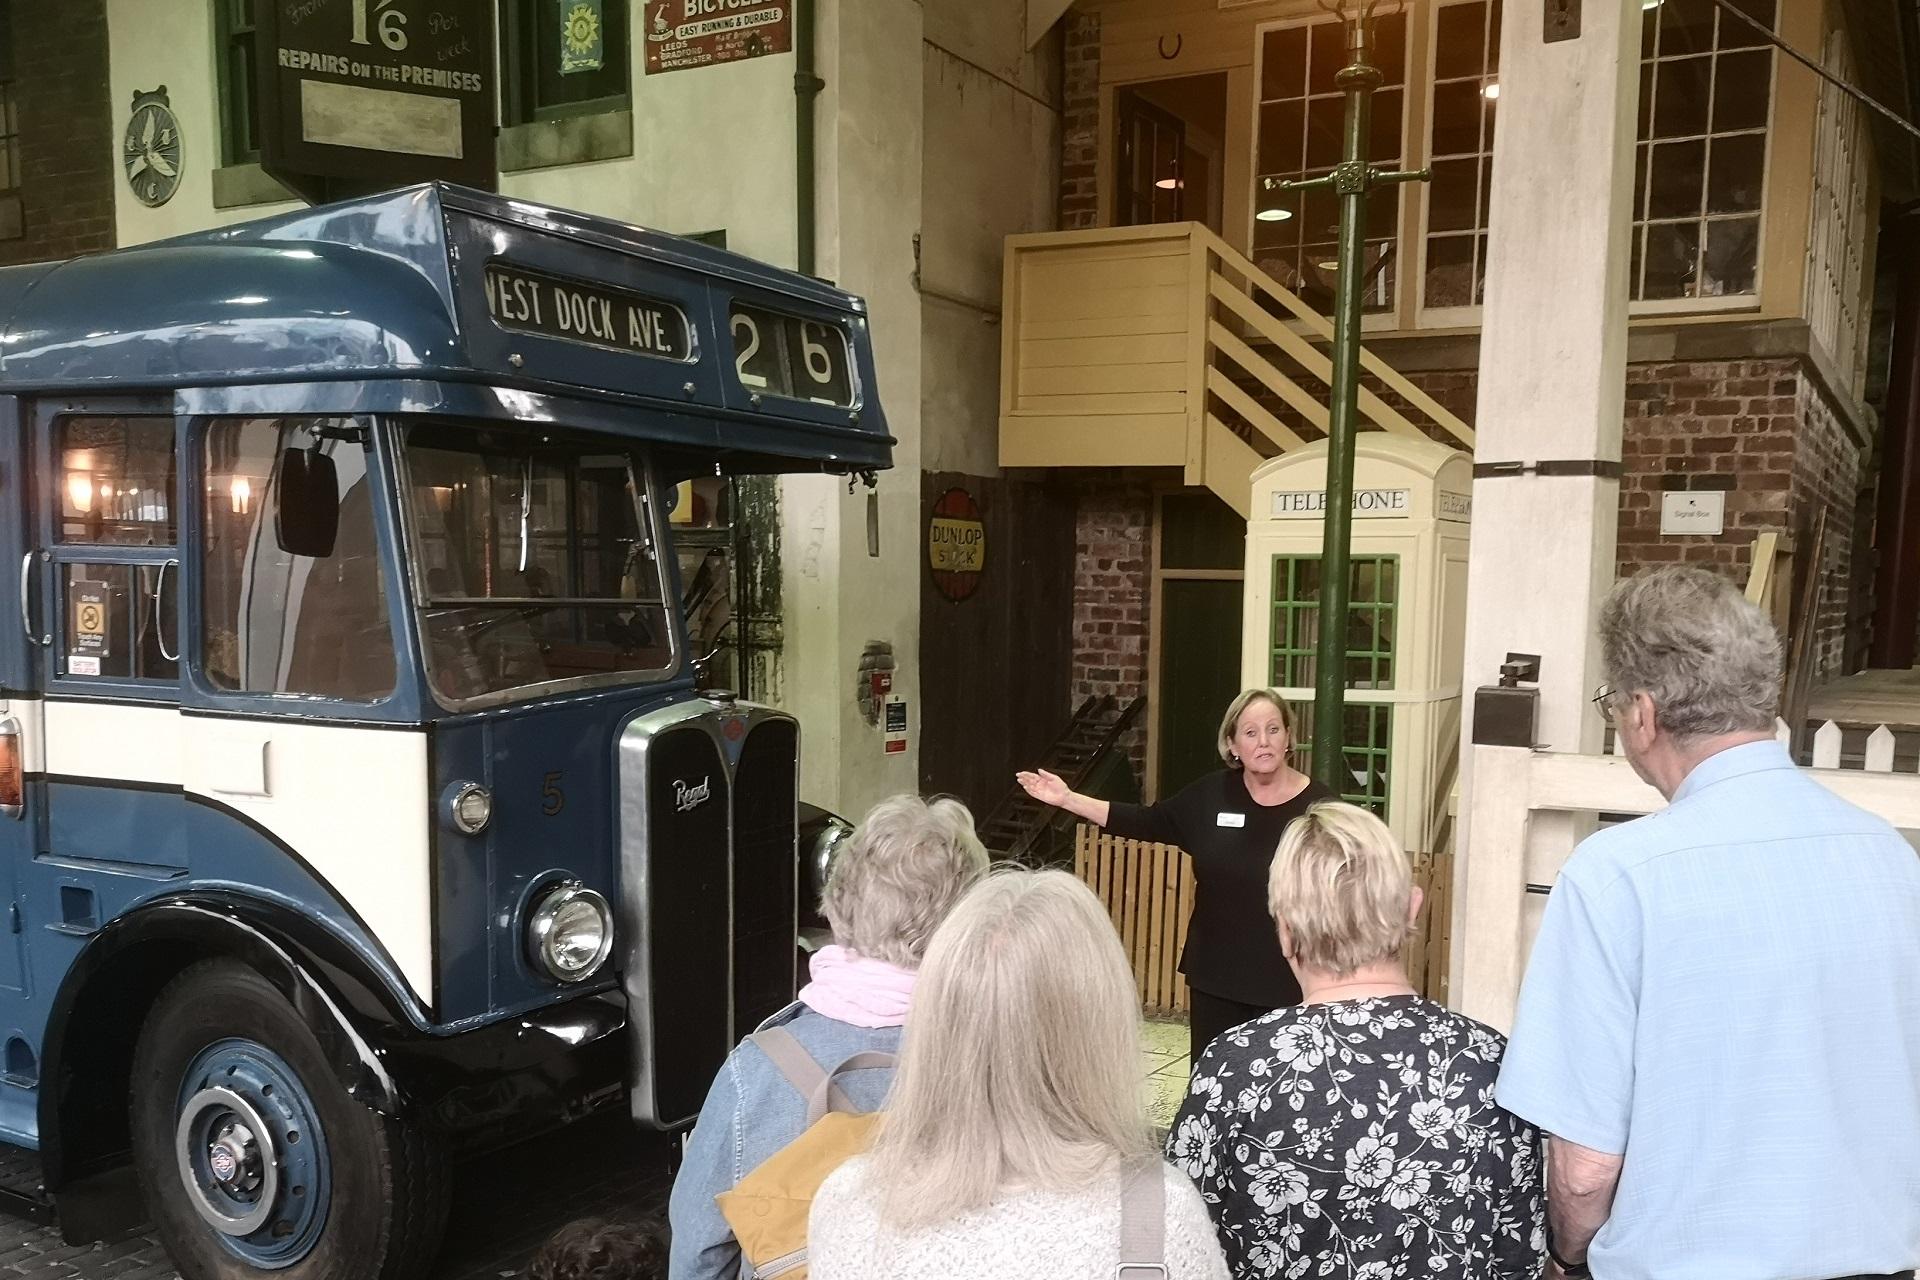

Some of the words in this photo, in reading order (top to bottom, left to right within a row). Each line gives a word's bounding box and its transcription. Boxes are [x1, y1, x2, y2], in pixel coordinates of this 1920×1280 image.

[684, 0, 772, 17] BICY
[680, 25, 699, 37] EASY
[702, 19, 734, 32] RUNNING
[736, 17, 742, 27] &
[744, 9, 778, 25] DURABLE
[660, 41, 688, 52] LEEDS
[660, 46, 703, 61] BRADFORD
[277, 48, 349, 75] REPAIRS
[351, 62, 371, 78] ON
[374, 65, 399, 82] THE
[401, 65, 482, 92] PREMISES
[661, 54, 712, 69] MANCHESTER
[554, 287, 616, 341] DOCK
[628, 306, 672, 352] AVE.
[1278, 491, 1405, 511] TELEONE
[933, 526, 982, 545] DUNLOP
[542, 771, 565, 815] 5
